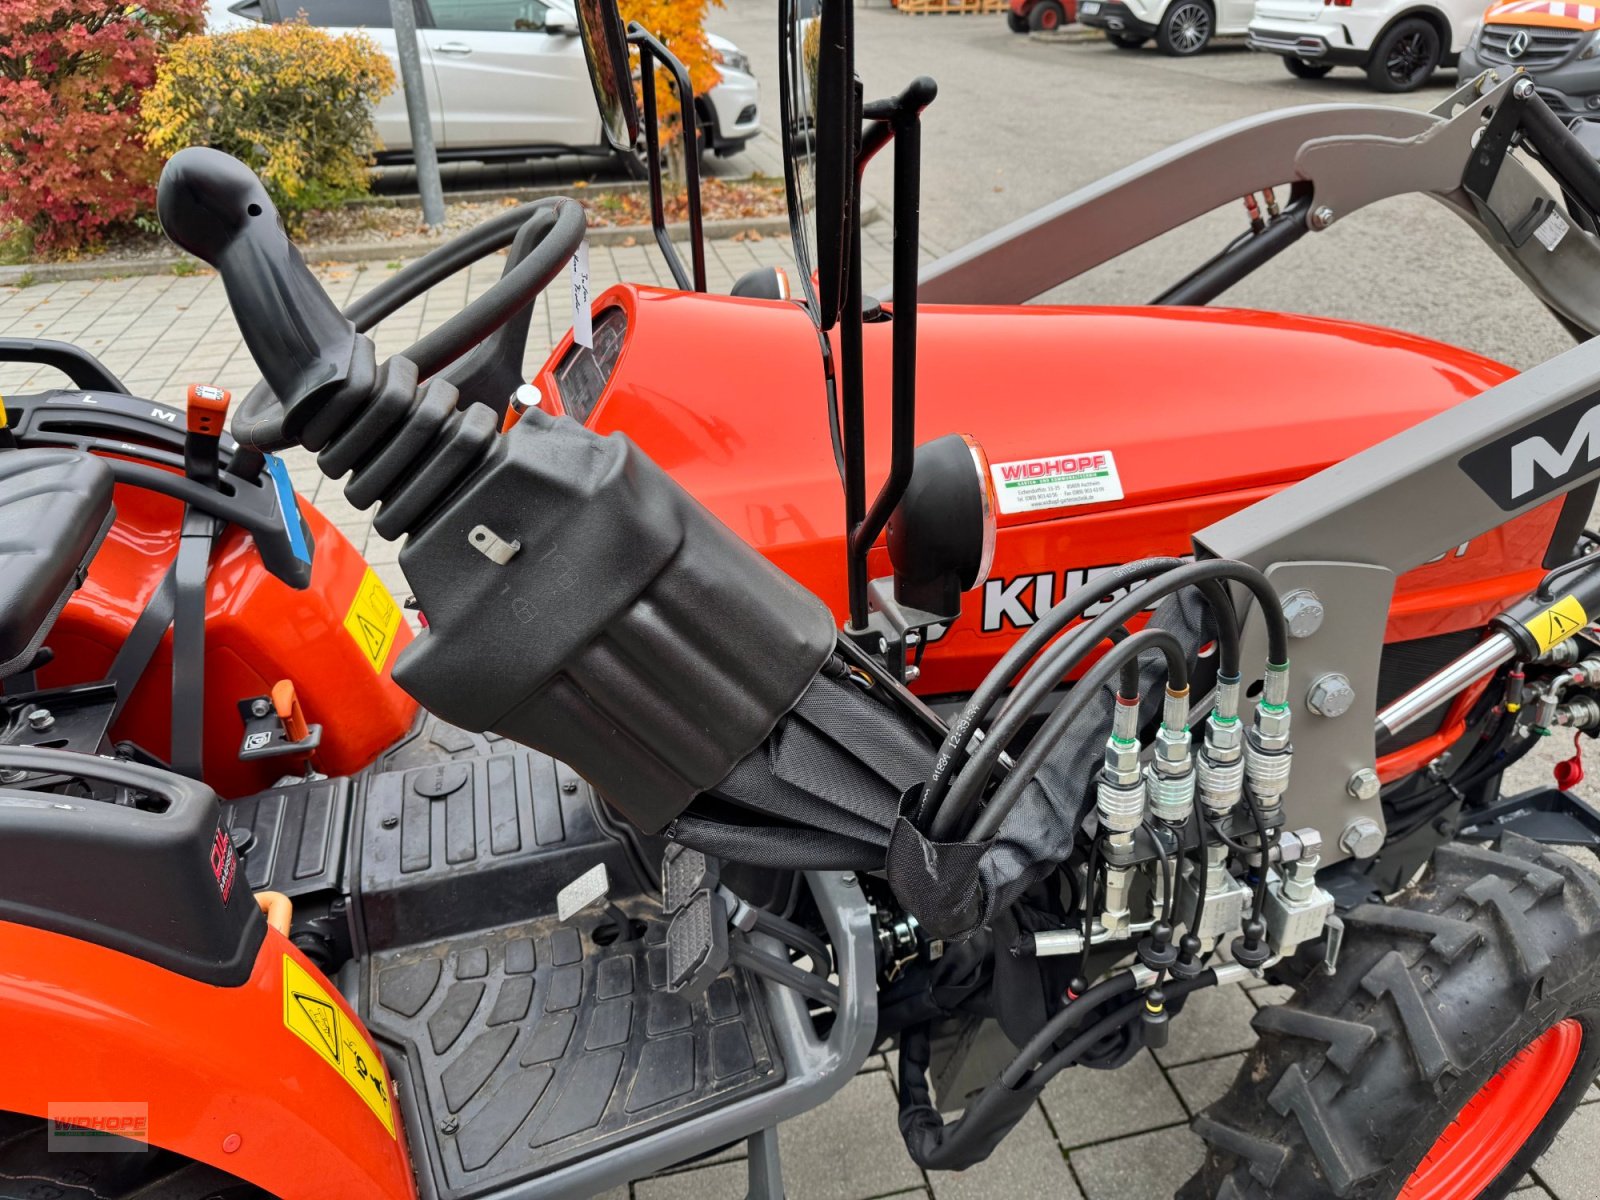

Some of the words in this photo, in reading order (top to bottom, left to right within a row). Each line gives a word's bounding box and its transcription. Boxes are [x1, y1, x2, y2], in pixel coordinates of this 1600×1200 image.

[82, 395, 98, 404] L
[151, 408, 177, 422] M
[1001, 455, 1106, 481] WIDHOPF
